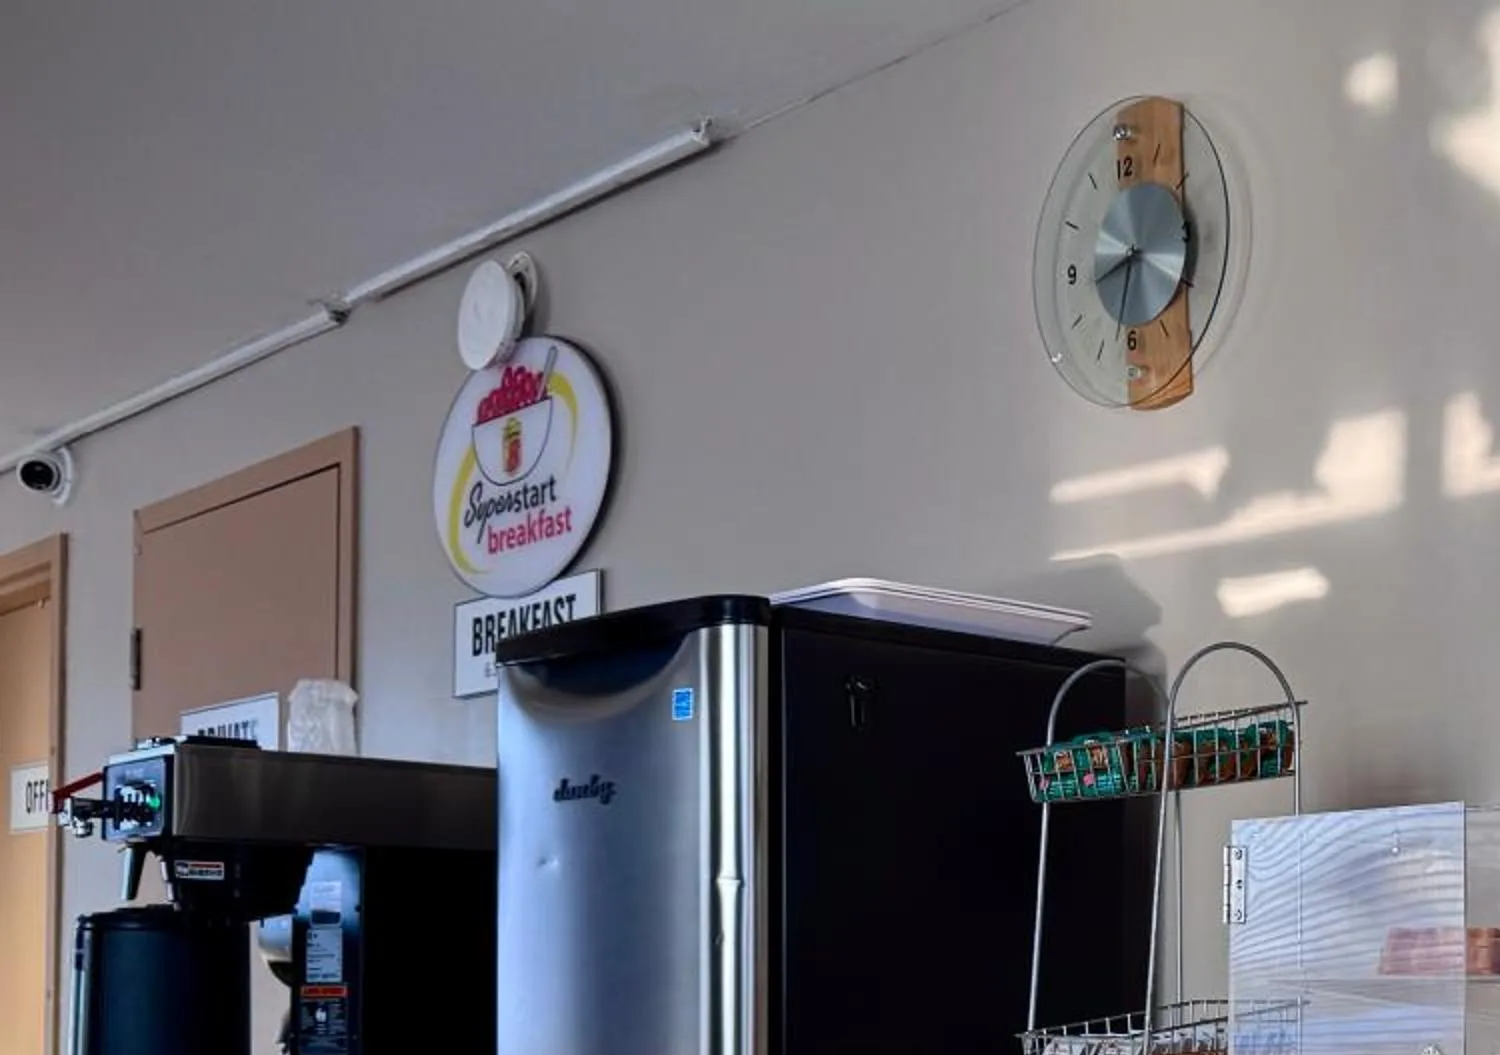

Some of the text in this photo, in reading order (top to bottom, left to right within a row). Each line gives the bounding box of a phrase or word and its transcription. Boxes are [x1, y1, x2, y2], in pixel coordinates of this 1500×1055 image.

[1116, 155, 1133, 181] 12
[1067, 264, 1077, 285] 9
[1127, 329, 1137, 351] 6
[487, 505, 573, 556] breakfast
[471, 593, 577, 657] BREAKFAST
